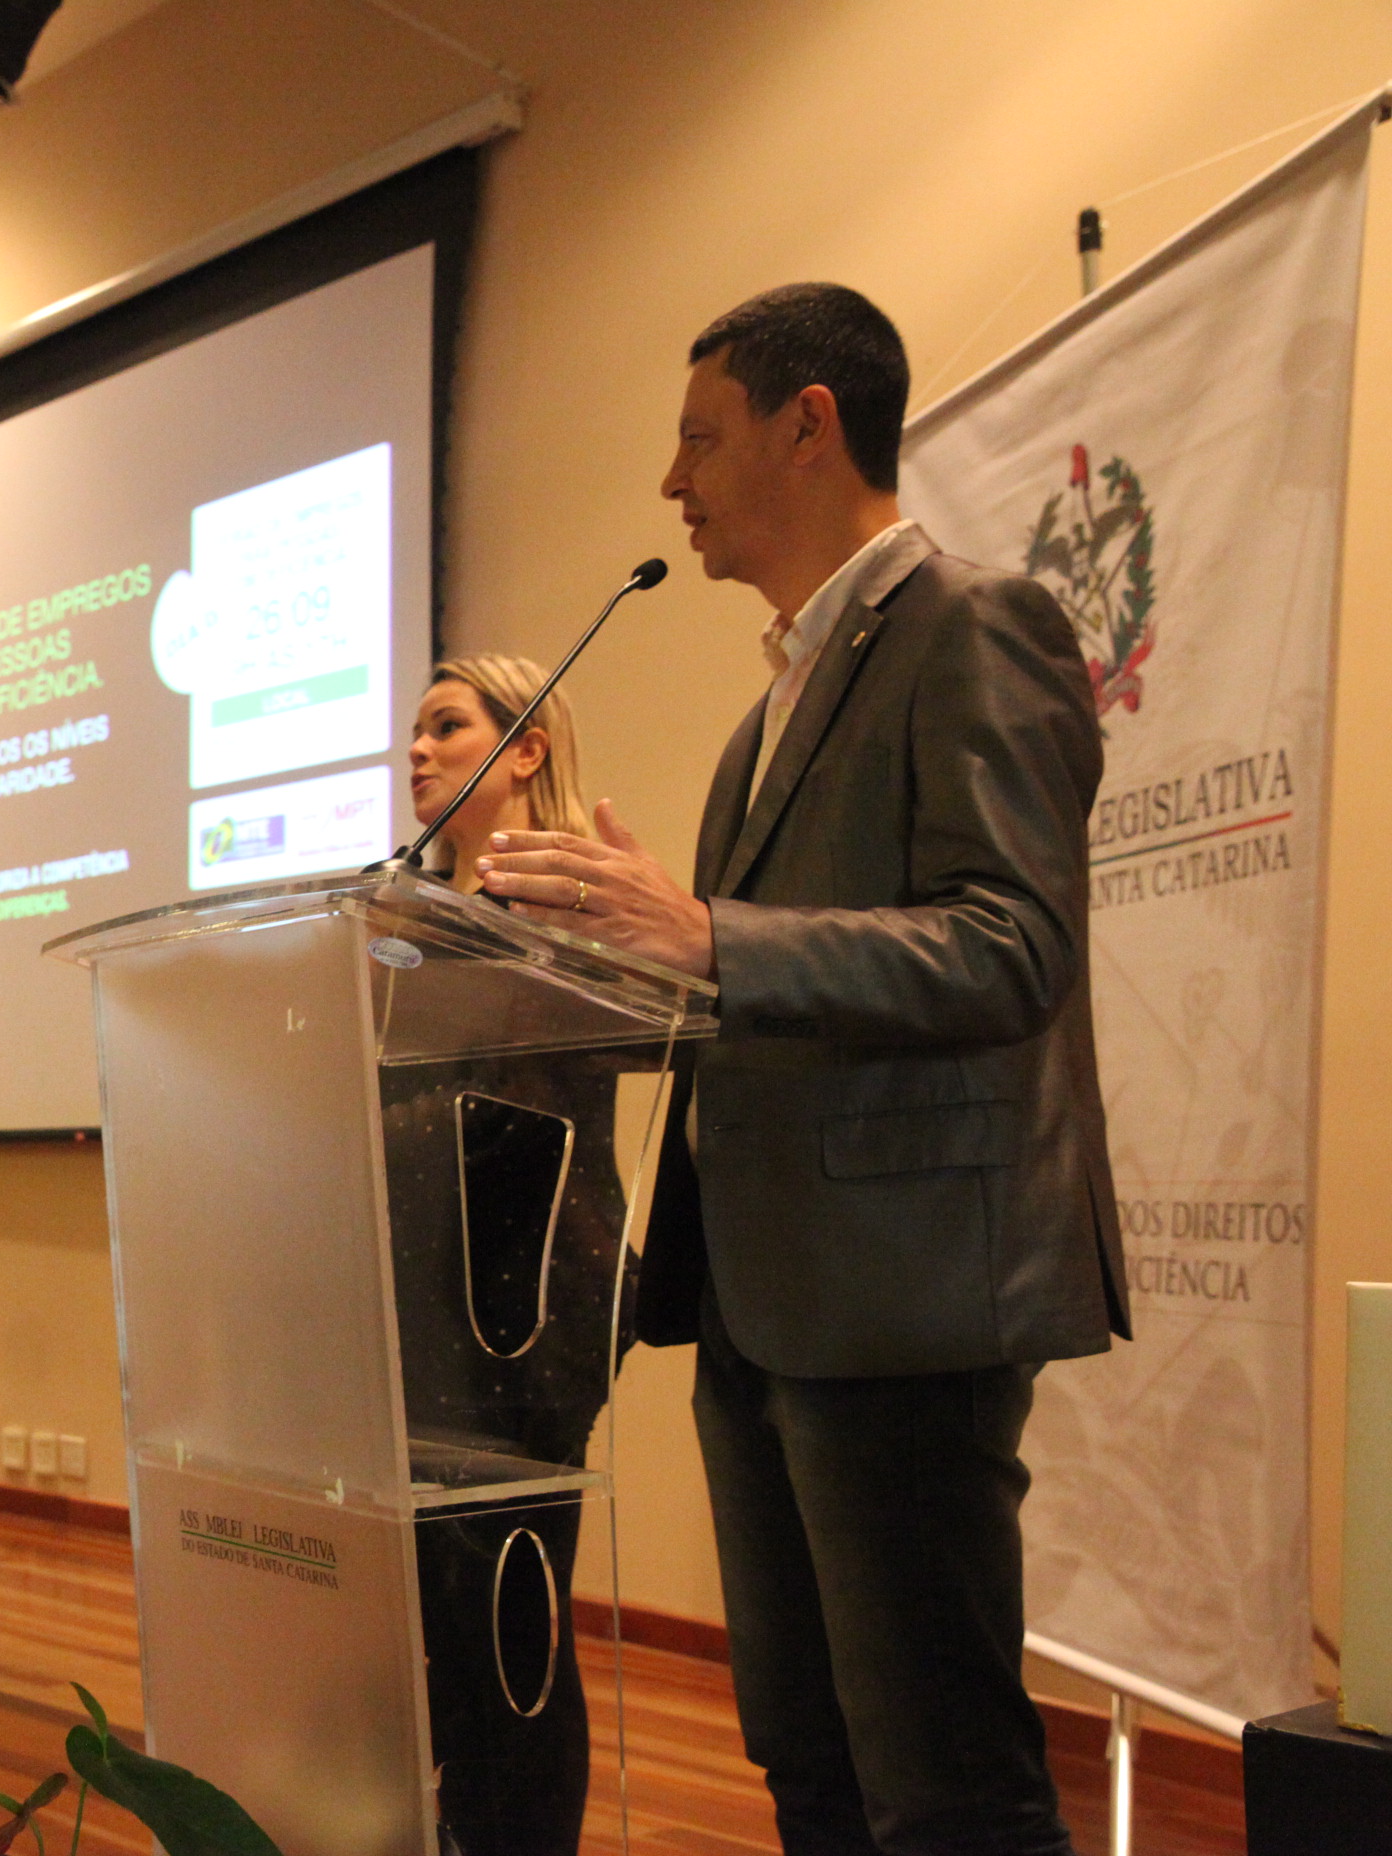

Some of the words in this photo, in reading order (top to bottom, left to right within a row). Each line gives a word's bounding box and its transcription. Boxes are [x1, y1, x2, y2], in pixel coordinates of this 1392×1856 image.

[26, 563, 152, 631] EMPREGOS
[23, 729, 49, 759] OS
[1152, 830, 1291, 897] CATARINA
[1170, 1200, 1306, 1245] DIREITOS
[181, 1537, 195, 1552] DO
[197, 1541, 234, 1562] ESTADO
[236, 1550, 250, 1567] DE
[252, 1553, 284, 1576] SANTA
[286, 1562, 339, 1590] CATARINA
[254, 1524, 336, 1562] LEGISLATIVA
